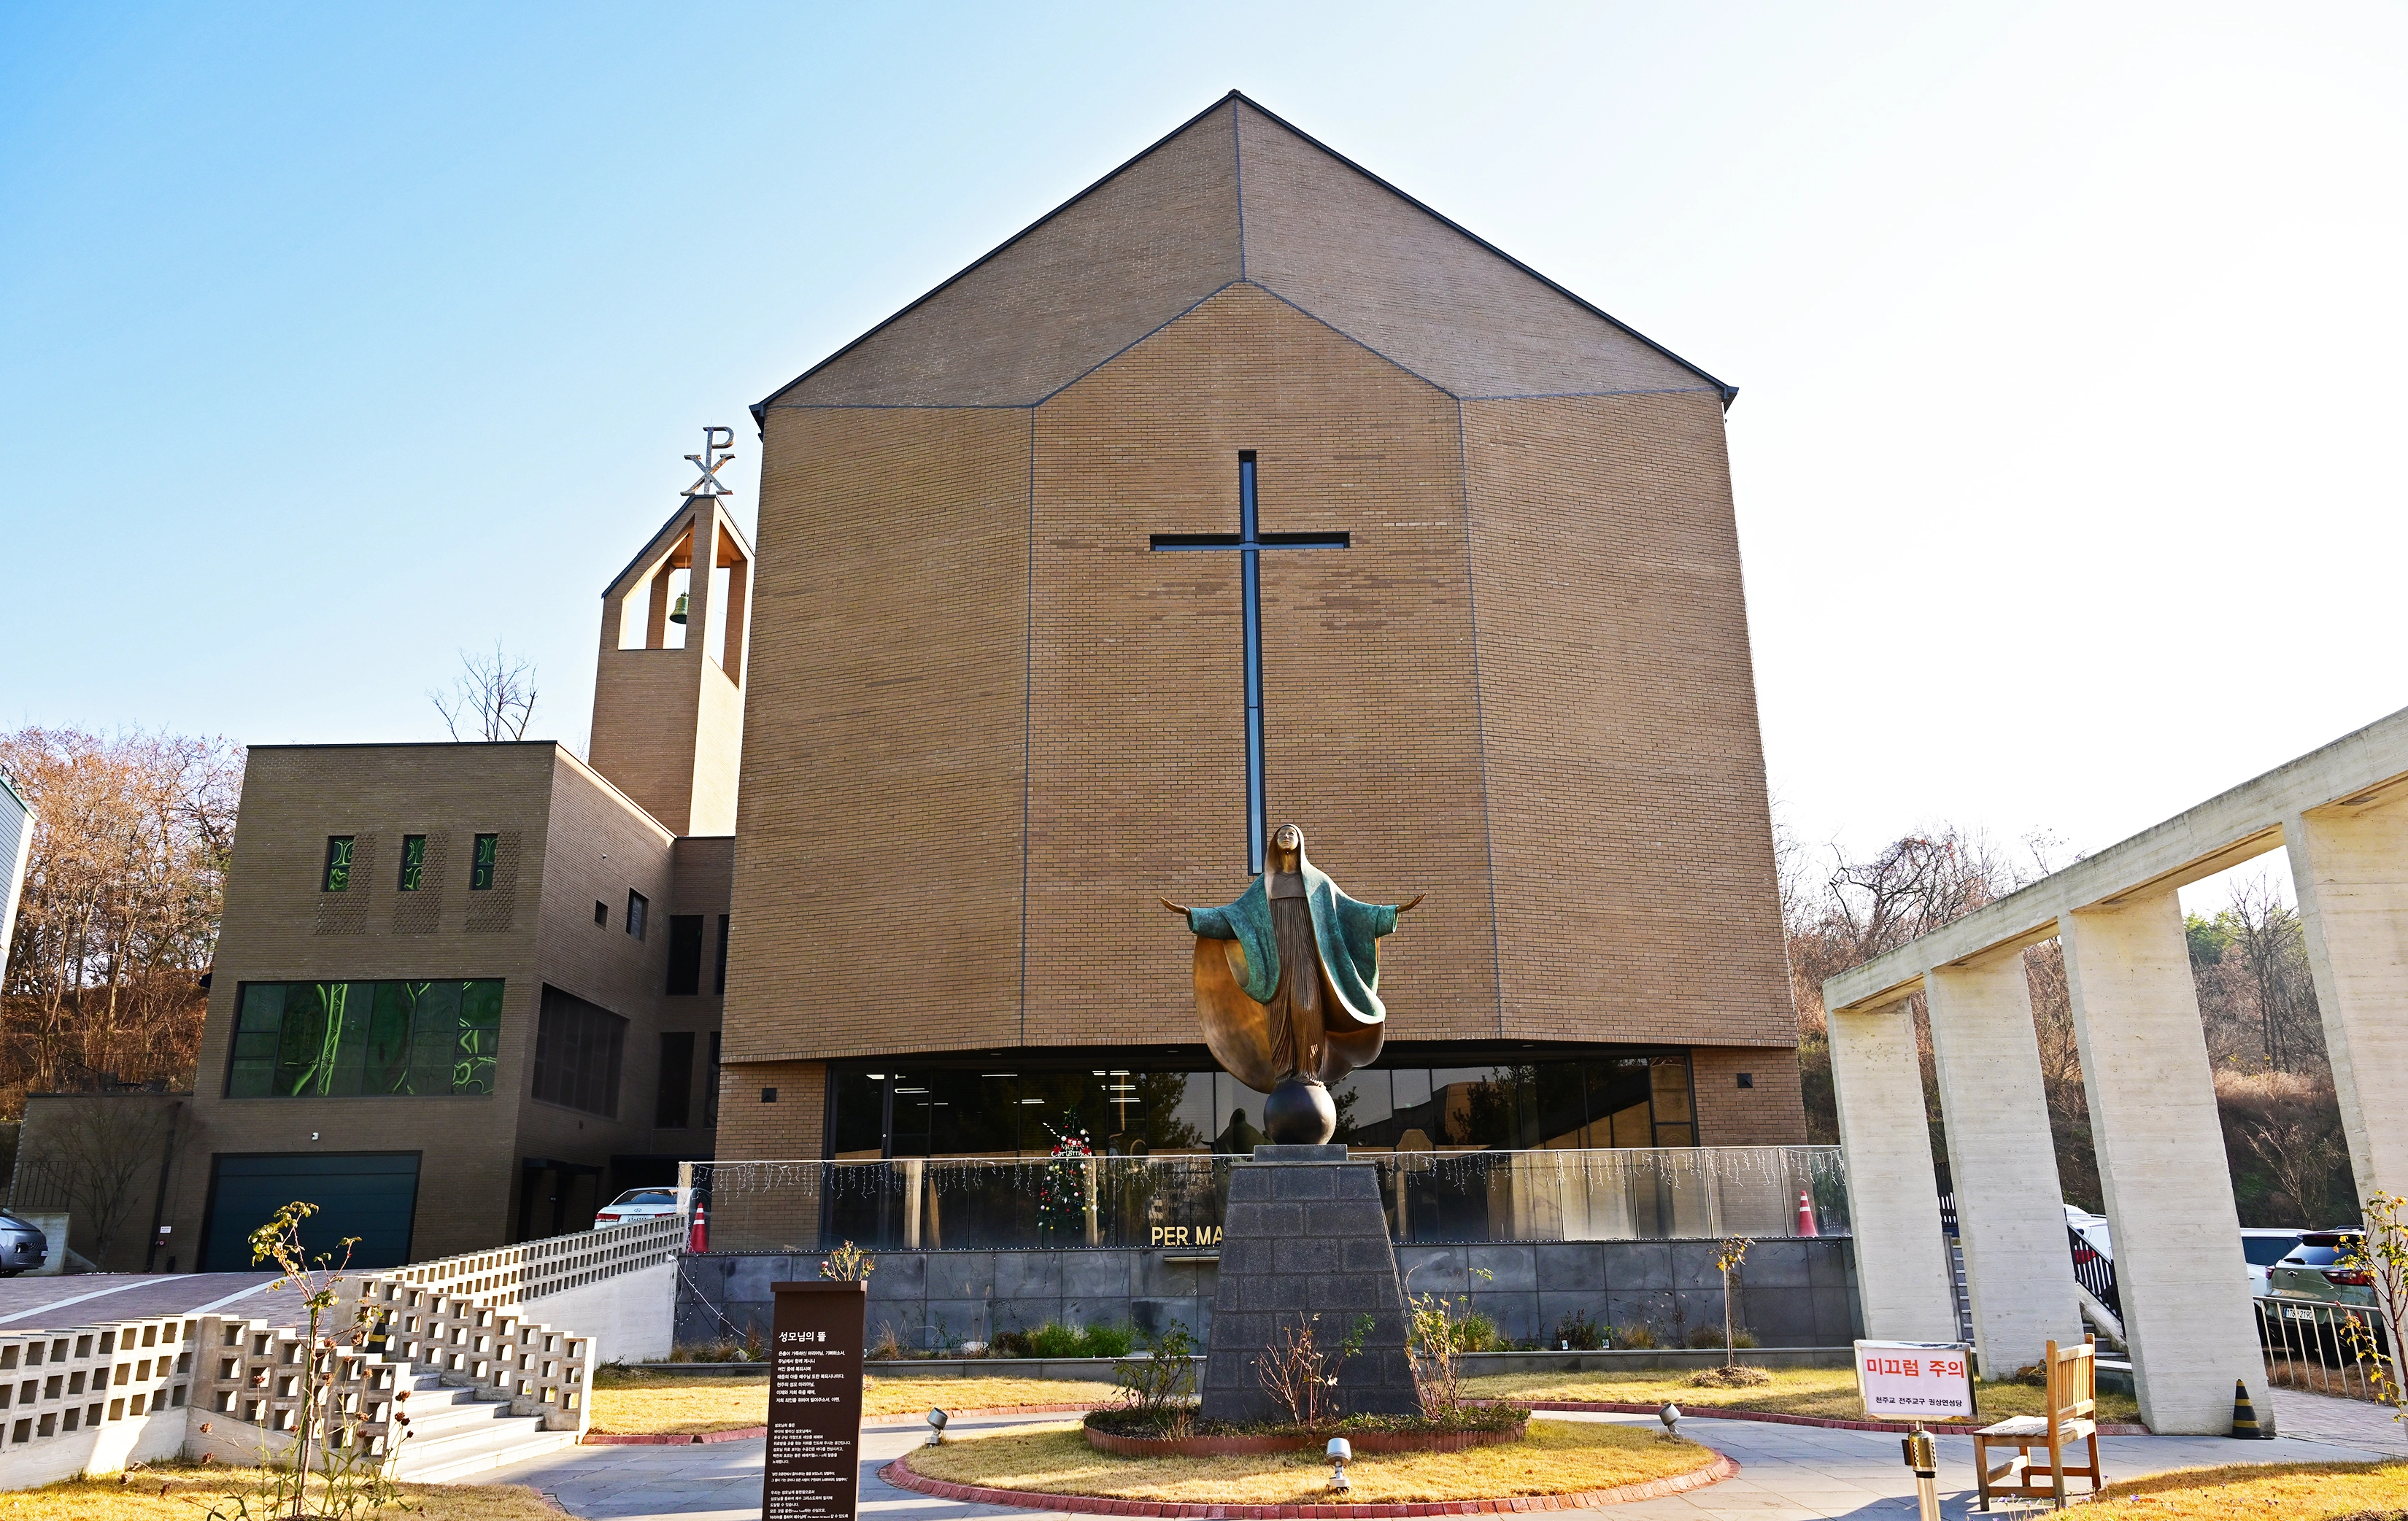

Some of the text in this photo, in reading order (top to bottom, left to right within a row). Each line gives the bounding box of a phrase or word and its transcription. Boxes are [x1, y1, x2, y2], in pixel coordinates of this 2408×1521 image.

[1151, 1226, 1189, 1246] PER
[779, 1331, 826, 1342] 성모님의 뜰
[1867, 1358, 1965, 1379] 미끄럼 주의
[1875, 1396, 1962, 1407] 천주교 전주교구 권상연성당
